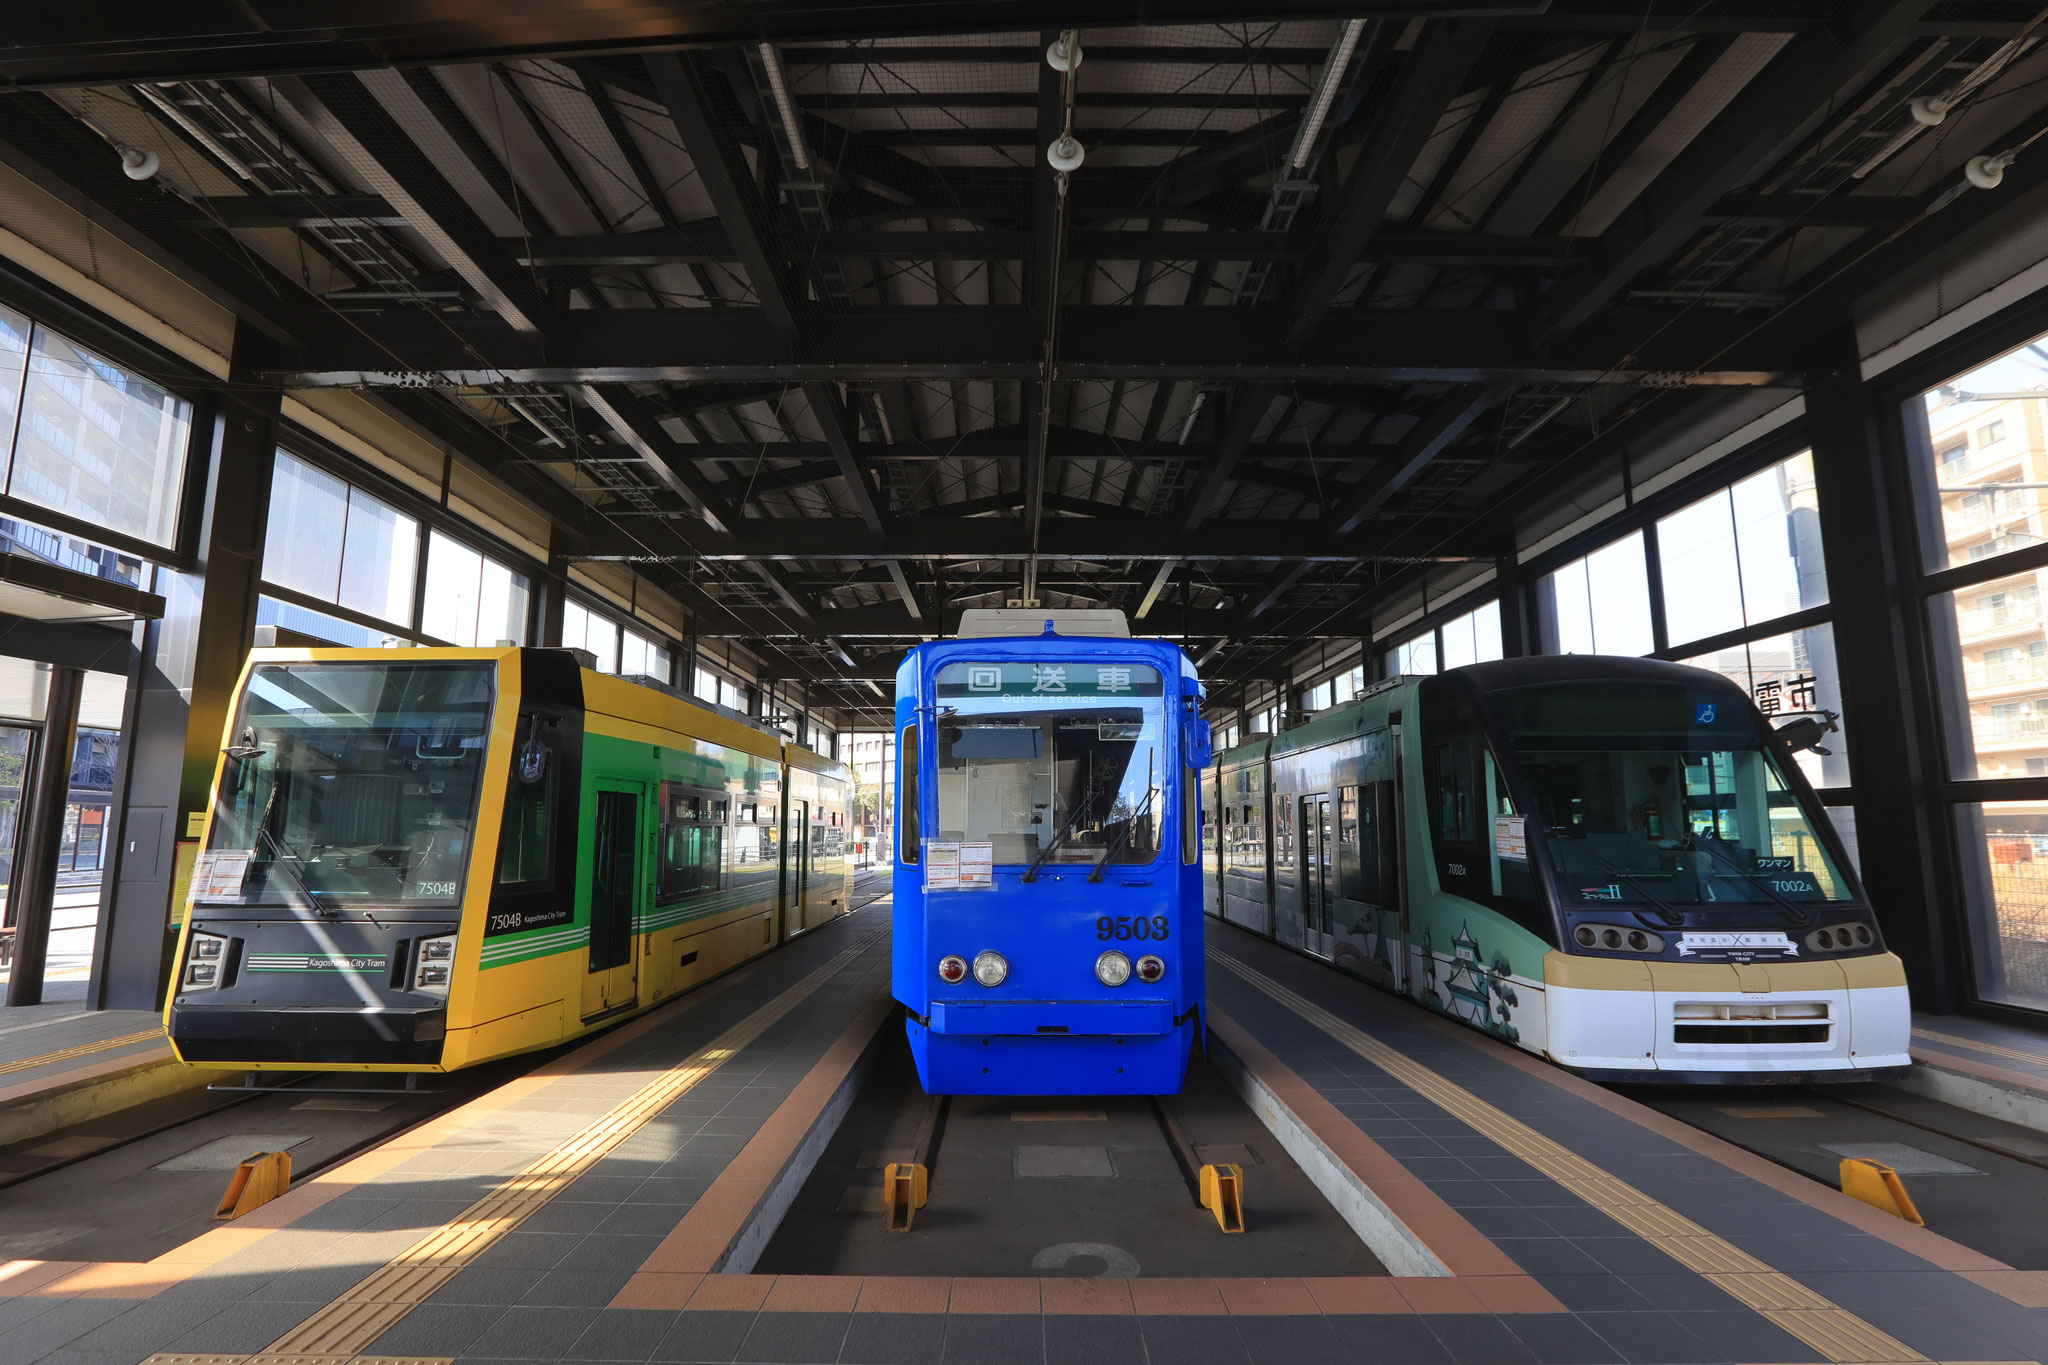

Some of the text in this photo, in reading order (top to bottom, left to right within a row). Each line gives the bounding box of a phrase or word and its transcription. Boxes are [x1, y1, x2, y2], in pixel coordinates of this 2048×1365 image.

[968, 666, 1132, 692] 回送車
[1002, 693, 1098, 704] Out of service
[1447, 863, 1467, 876] 7002A
[1757, 859, 1792, 868] ワンマン
[418, 882, 457, 895] 7504B
[1771, 880, 1814, 892] 7002A
[491, 911, 567, 931] 7504B Kagoshima City Tram
[1096, 916, 1169, 941] 9503
[309, 958, 385, 969] Kagoshima City Tram
